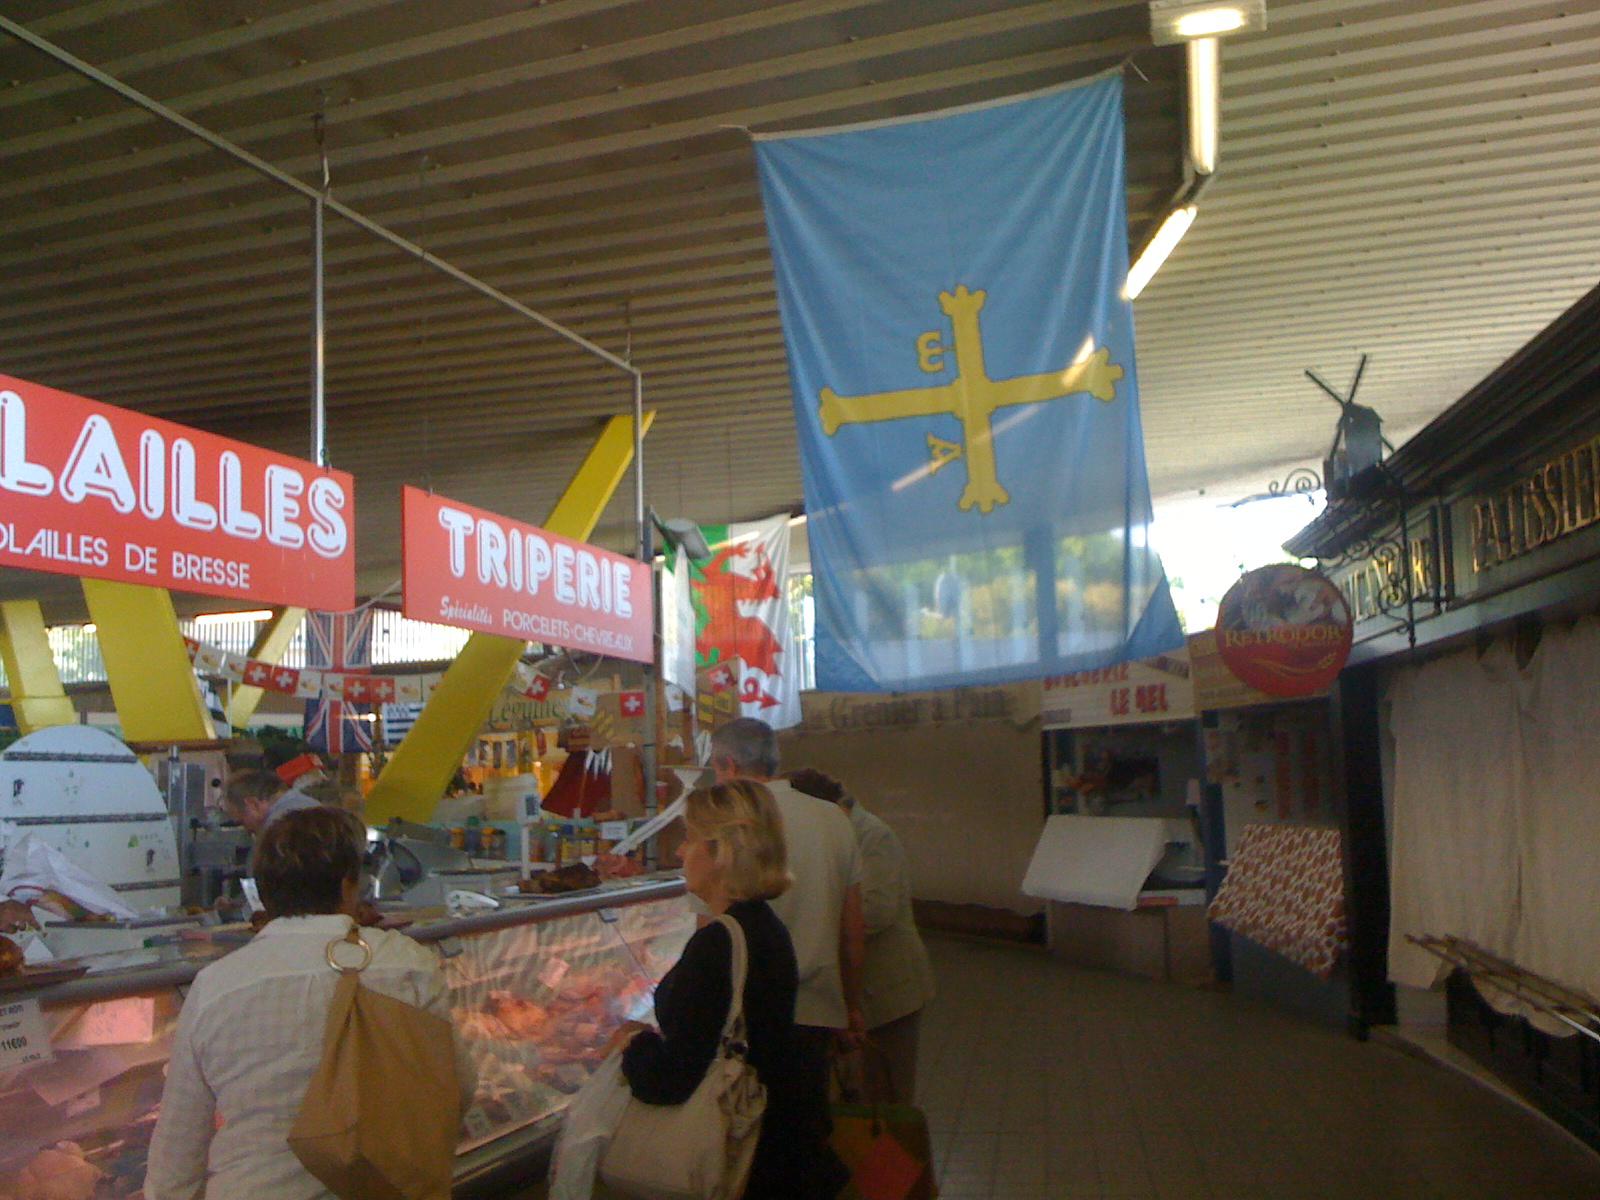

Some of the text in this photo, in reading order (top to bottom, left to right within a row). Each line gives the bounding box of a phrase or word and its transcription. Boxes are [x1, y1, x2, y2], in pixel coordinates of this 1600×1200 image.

[124, 542, 158, 575] DE
[172, 551, 251, 589] BRESSE
[438, 506, 633, 619] TRIPERIE
